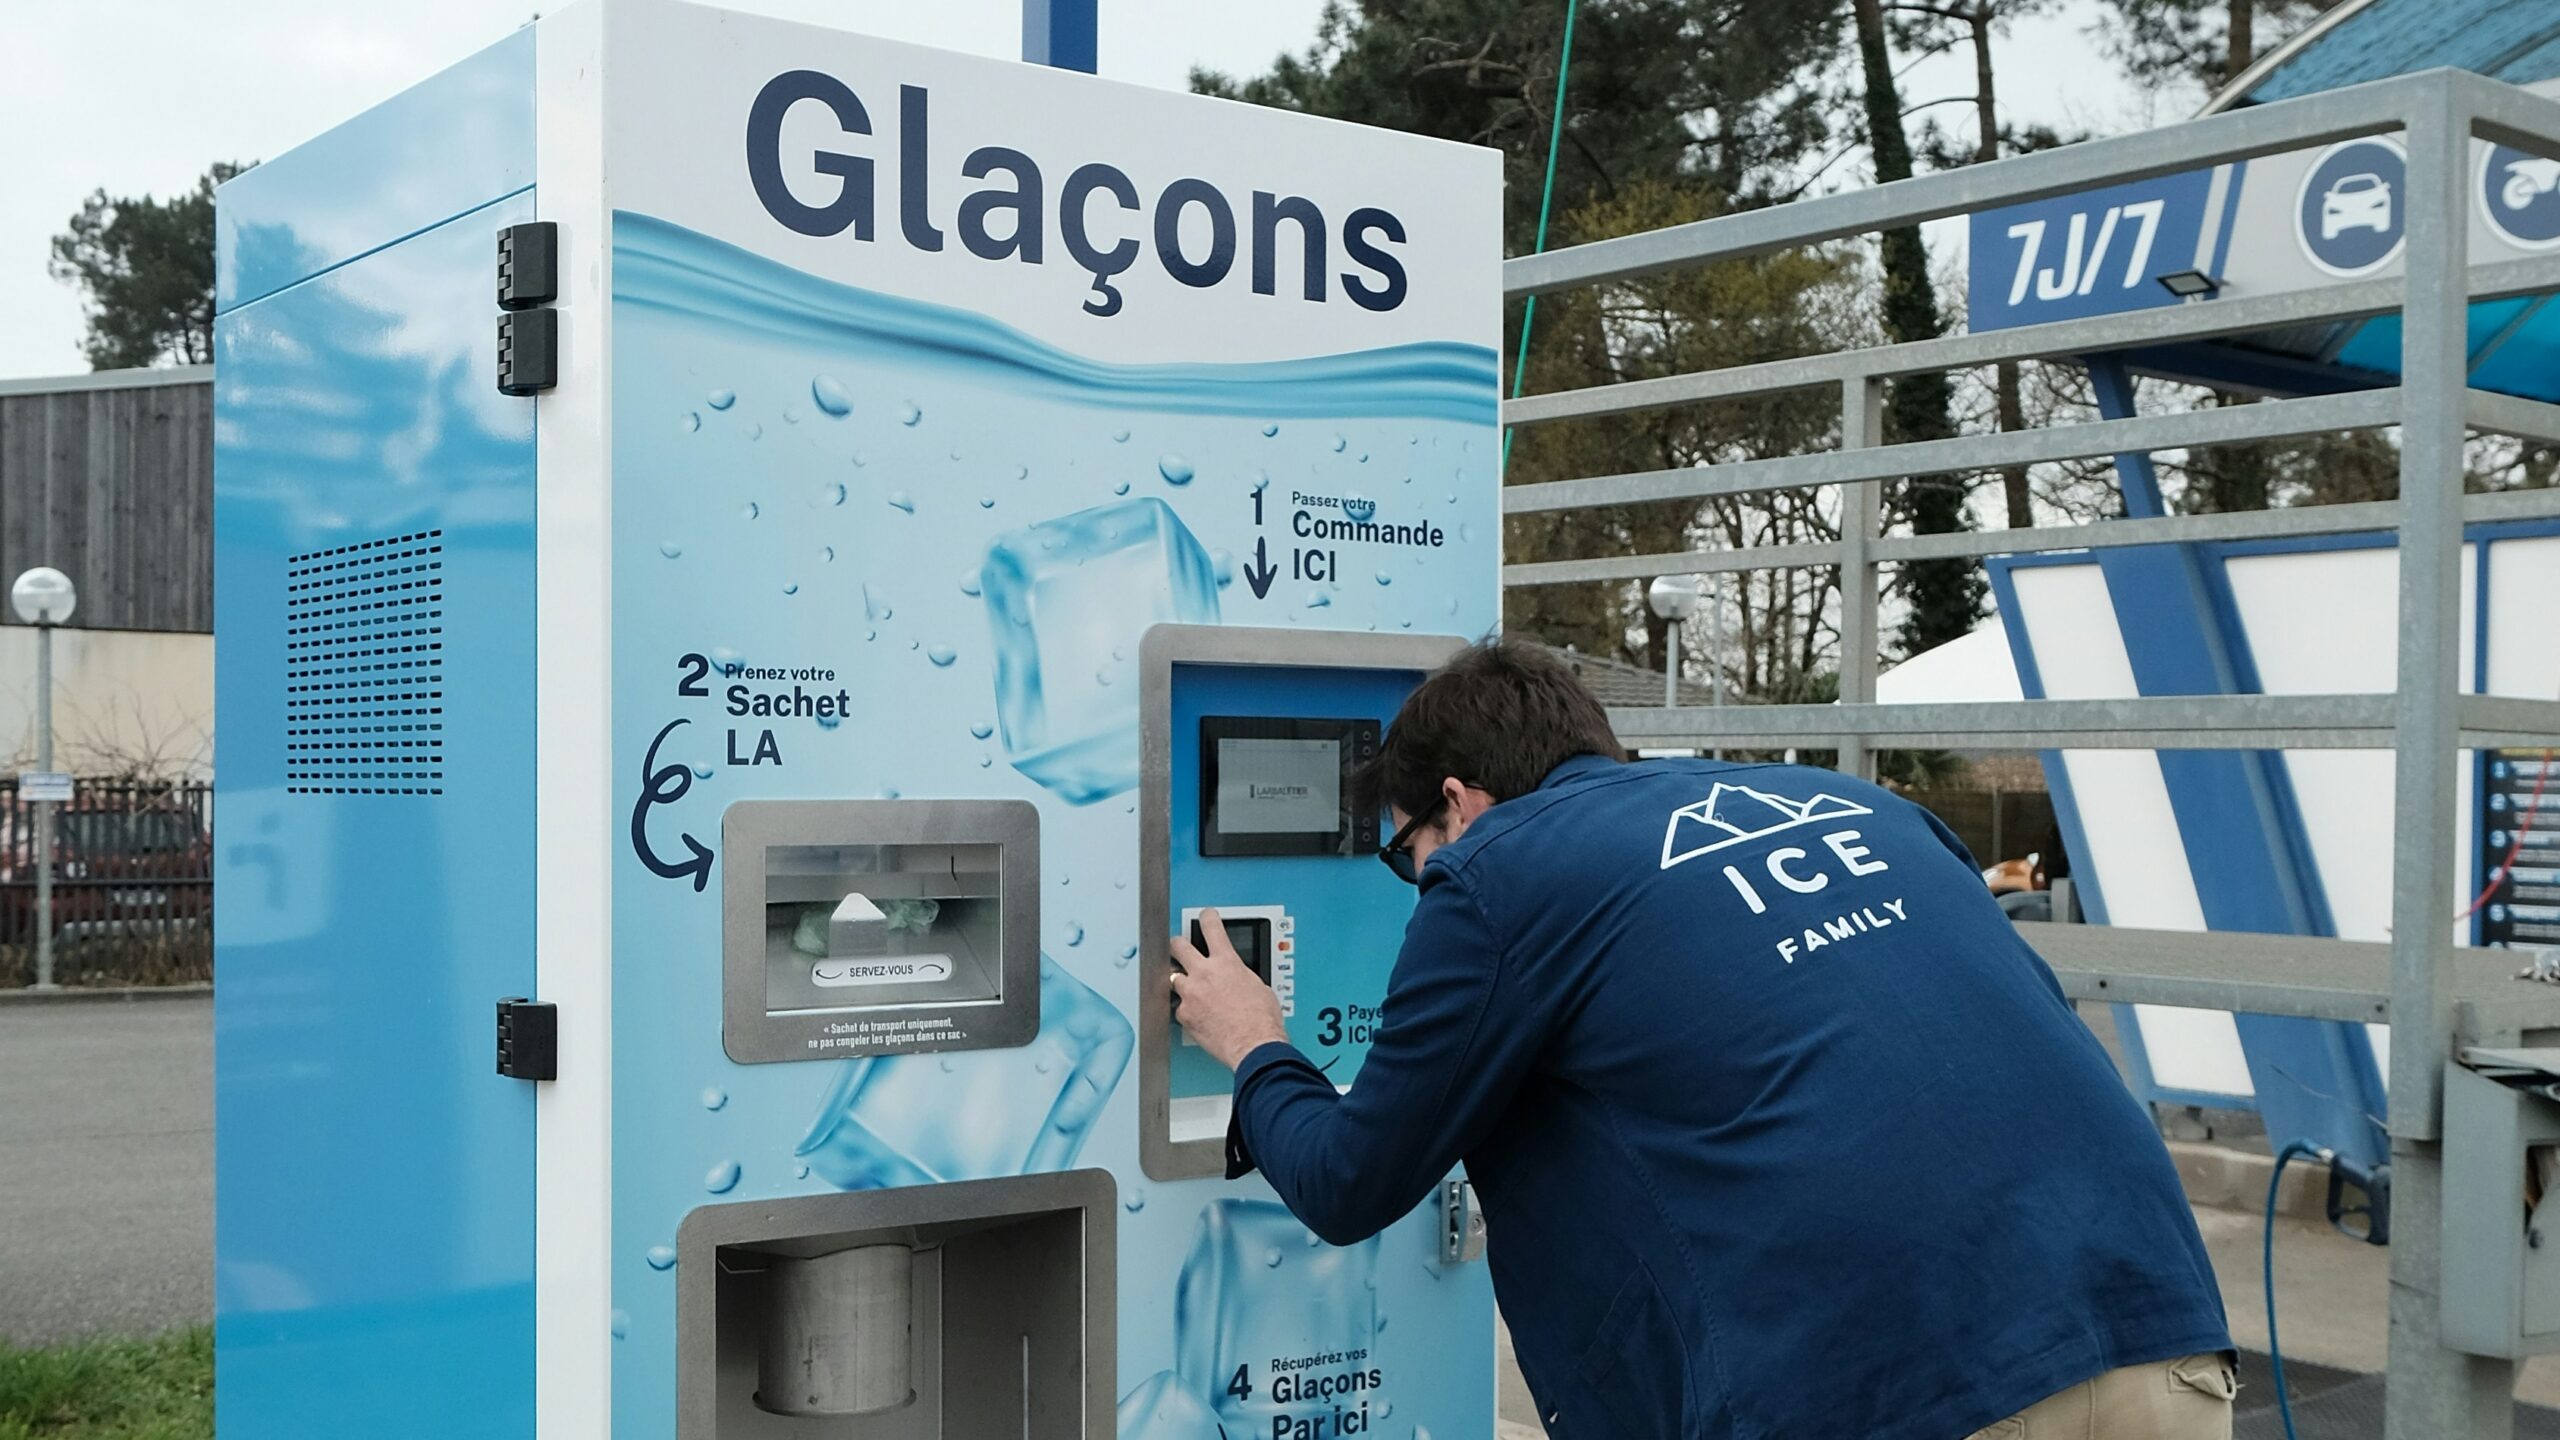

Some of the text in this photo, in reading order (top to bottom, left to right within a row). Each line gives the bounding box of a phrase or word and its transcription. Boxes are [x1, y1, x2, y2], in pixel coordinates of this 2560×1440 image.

[746, 69, 1408, 317] Glaçons
[2008, 199, 2165, 306] 7J/7
[1250, 488, 1263, 525] 1
[1292, 491, 1376, 512] Passez votre
[1292, 510, 1444, 547] Commande
[1293, 548, 1336, 582] ICI
[677, 653, 710, 697] 2
[725, 663, 835, 681] Prenez votre
[726, 684, 850, 718] Sachet
[727, 729, 783, 766] LA
[1722, 829, 1889, 915] ICE
[1776, 898, 1908, 964] FAMILY
[849, 964, 914, 978] SERVEZ-VOUS
[831, 1022, 858, 1035] Sachet
[859, 1021, 869, 1033] de
[870, 1020, 906, 1034] transport
[1317, 1006, 1343, 1047] 3
[1348, 1004, 1384, 1022] Paye
[808, 1039, 818, 1049] ne
[820, 1038, 835, 1051] pas
[836, 1034, 870, 1049] congeler
[871, 1033, 884, 1045] les
[885, 1031, 915, 1046] glaçons
[916, 1030, 935, 1042] dans
[936, 1031, 946, 1041] ce
[947, 1030, 961, 1041] sac
[1348, 1024, 1373, 1044] ICI
[1271, 1348, 1368, 1373] Récupérez vos
[1227, 1363, 1253, 1401] 4
[1272, 1368, 1382, 1404] Glaçons
[1272, 1401, 1368, 1440] Par ici
